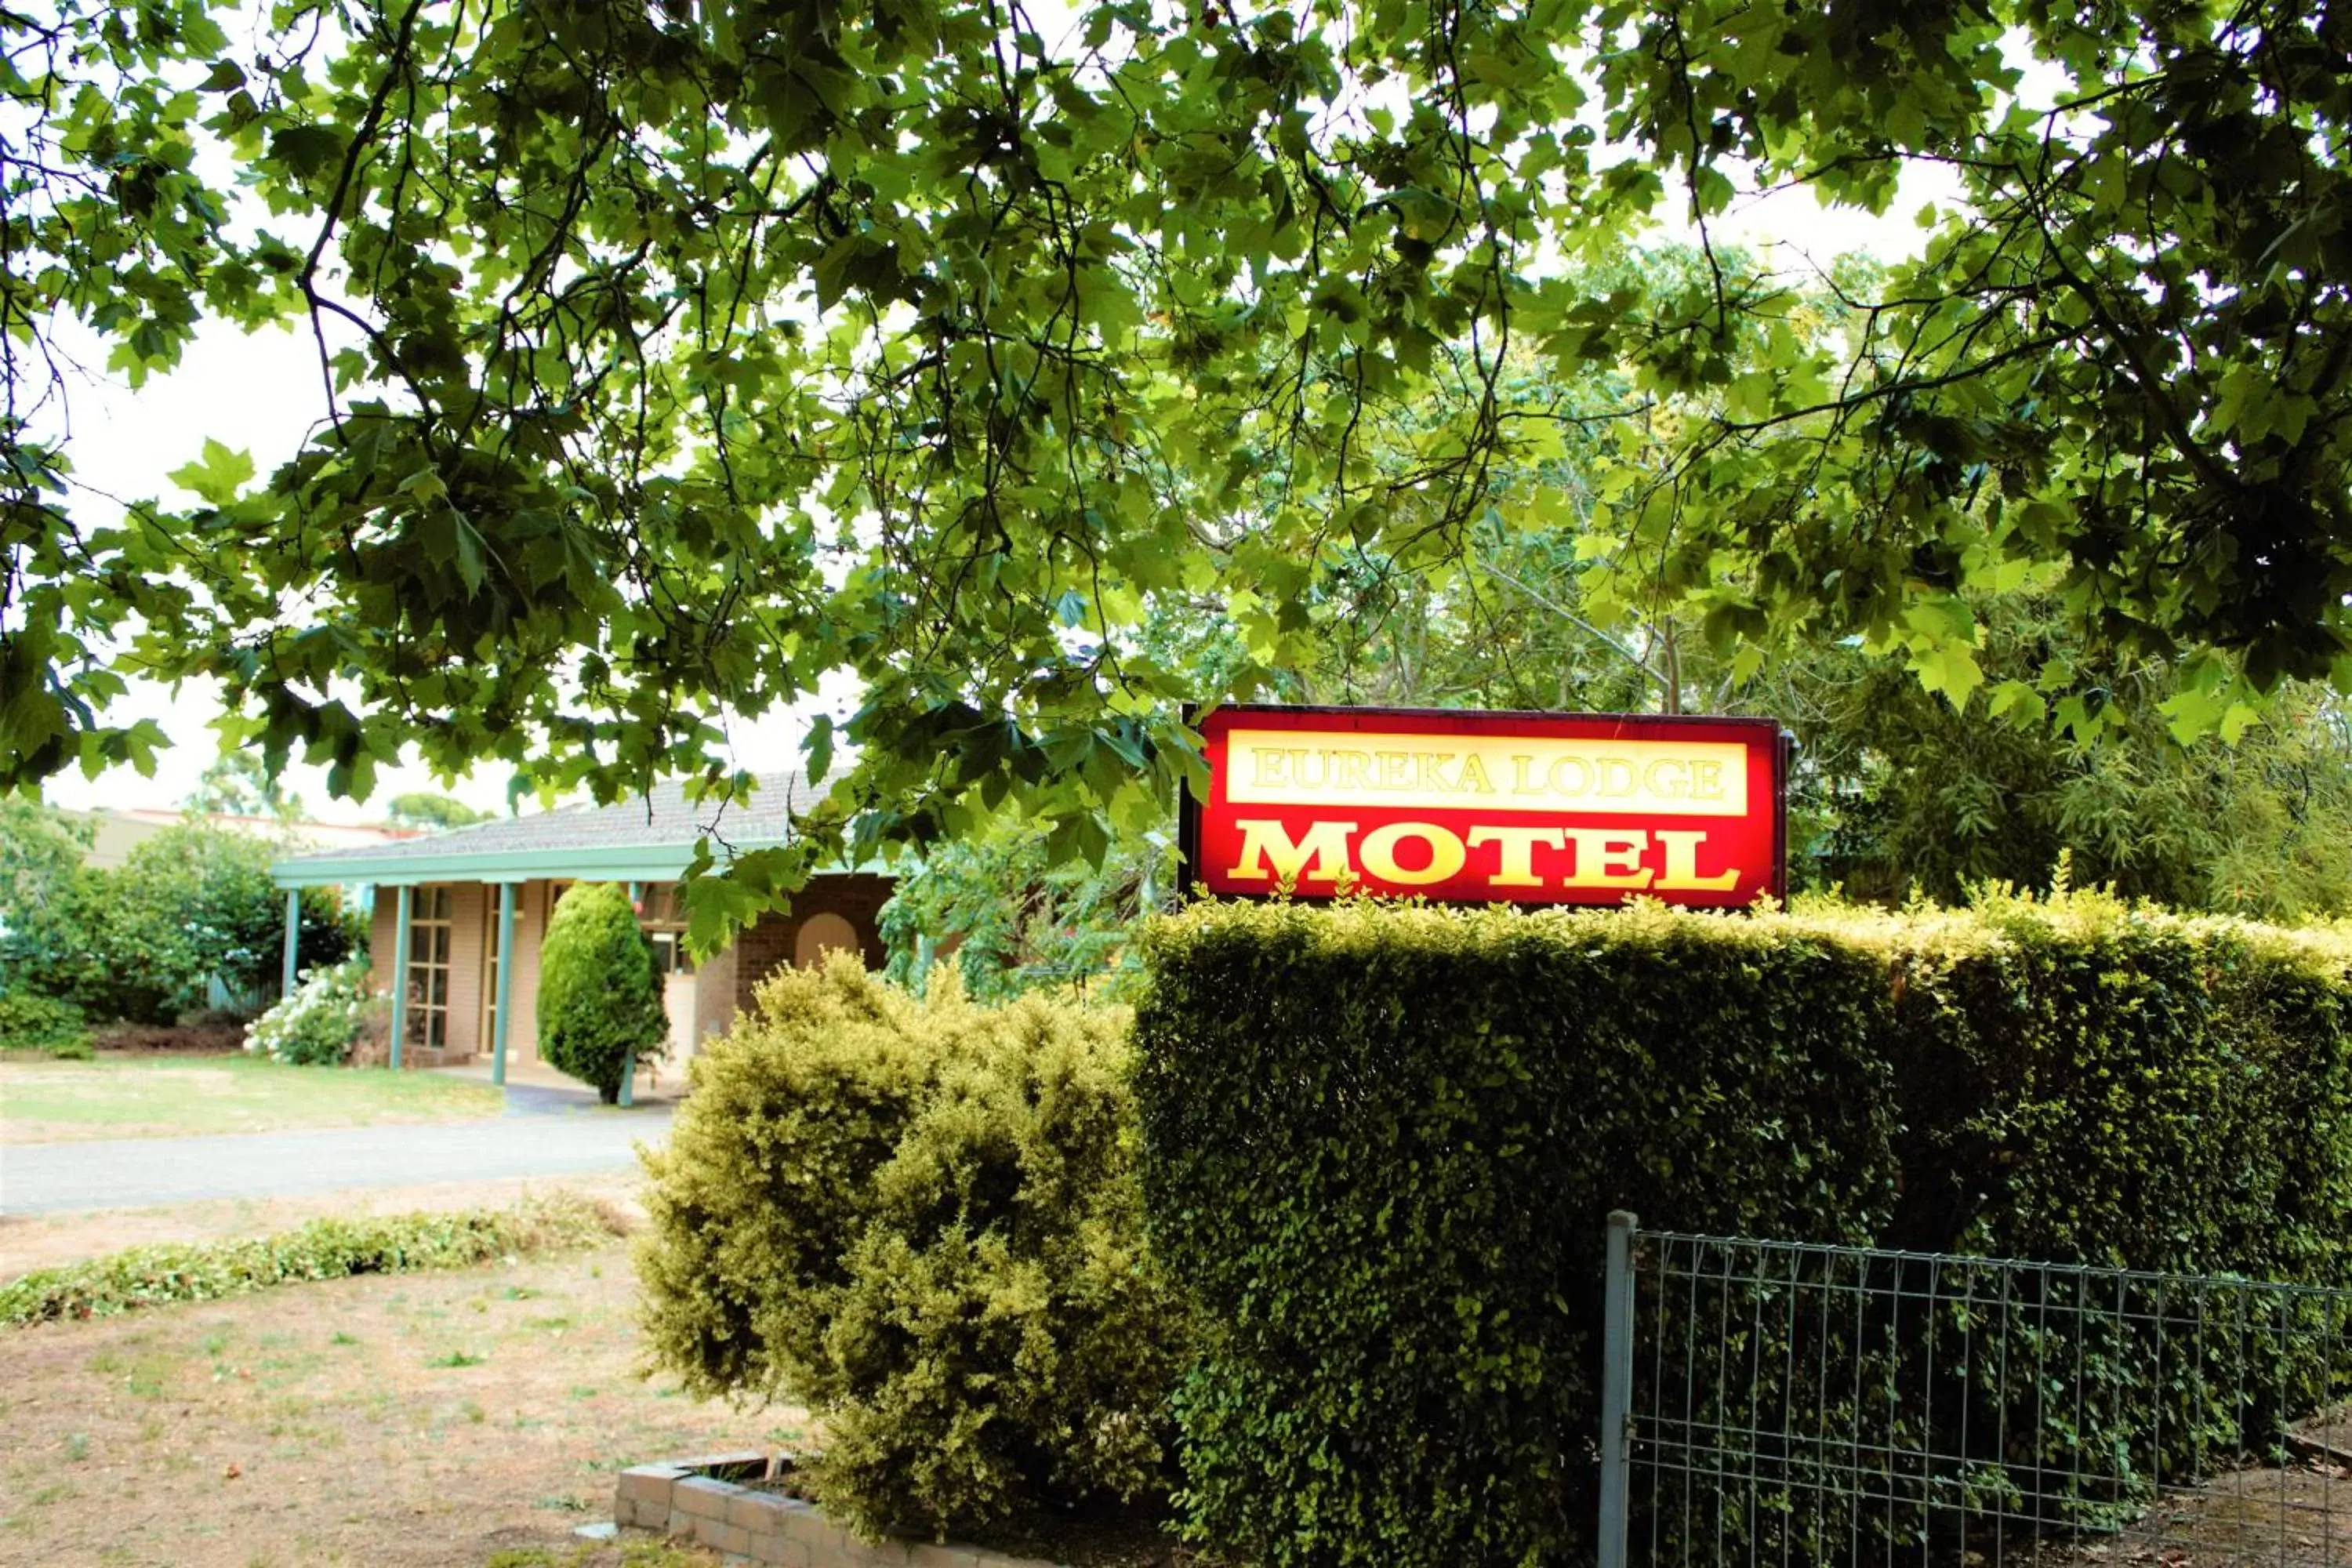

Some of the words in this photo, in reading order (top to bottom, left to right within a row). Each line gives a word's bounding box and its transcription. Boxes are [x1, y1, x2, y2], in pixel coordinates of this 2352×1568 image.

[1252, 748, 1494, 793] EUREKA
[1512, 755, 1725, 799] LODGE
[1228, 819, 1740, 891] MOTEL
